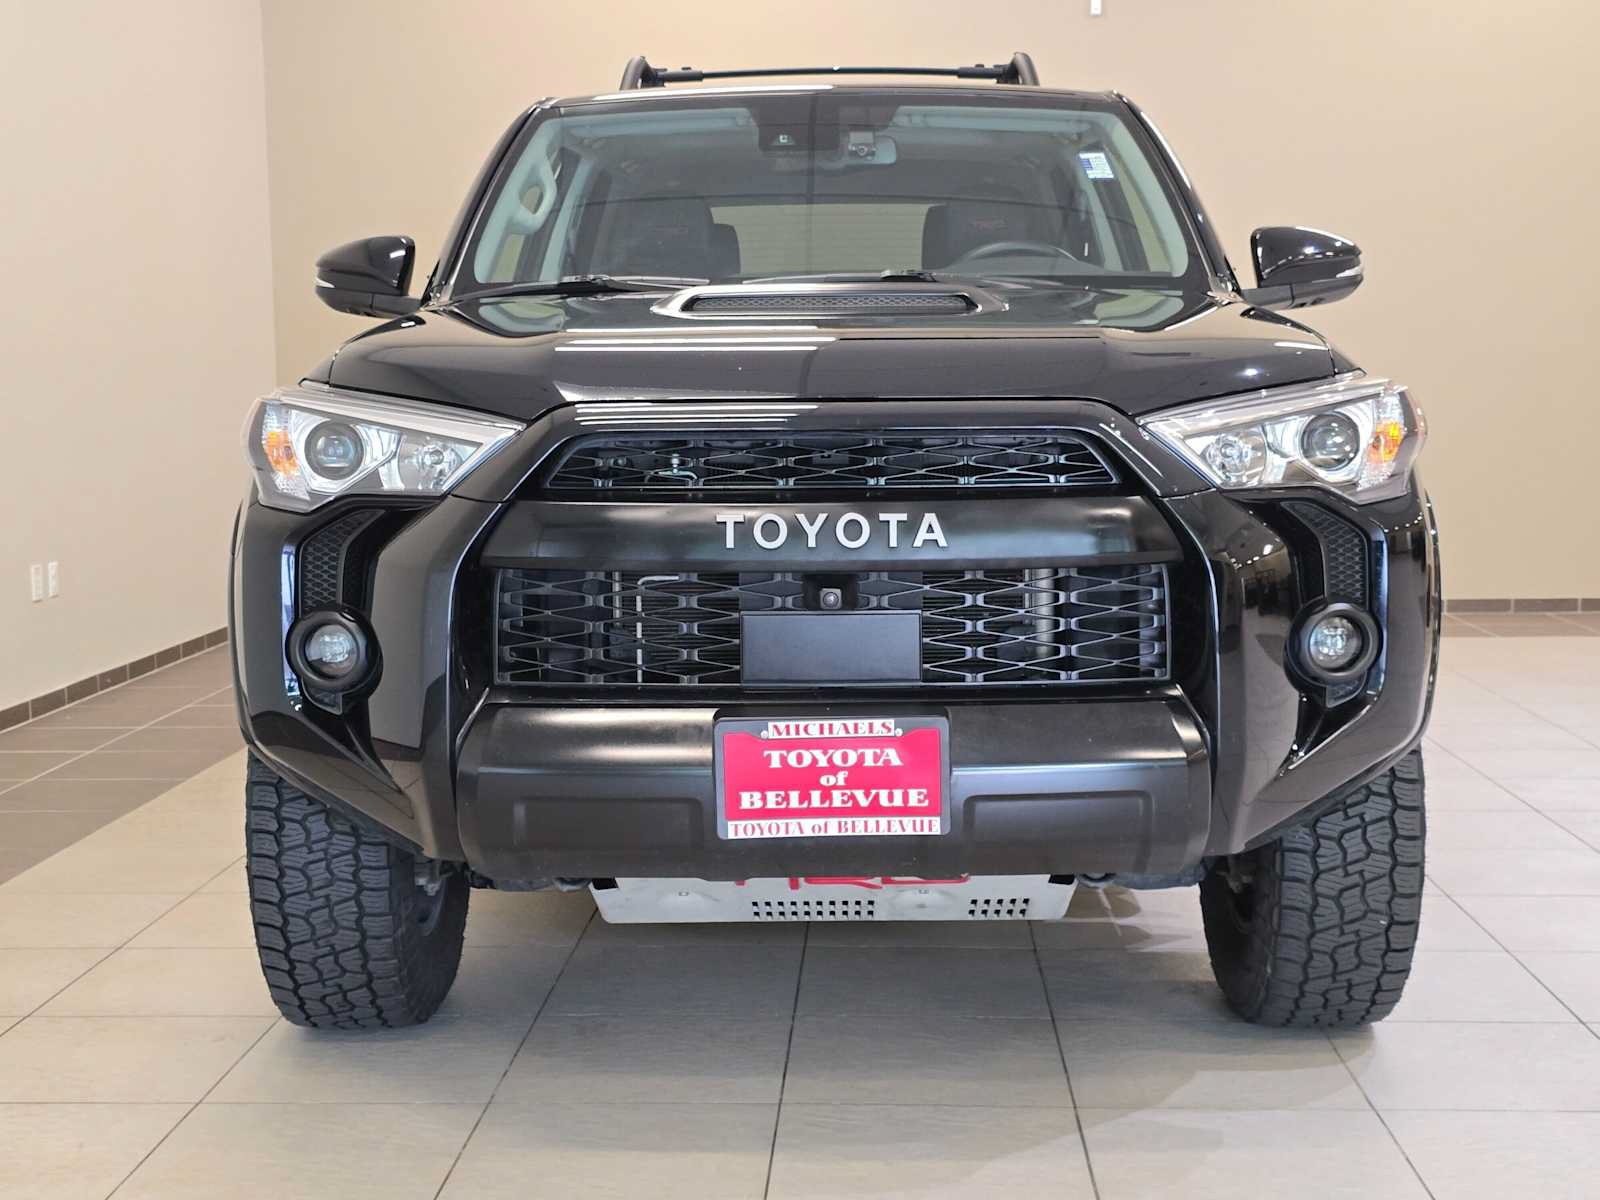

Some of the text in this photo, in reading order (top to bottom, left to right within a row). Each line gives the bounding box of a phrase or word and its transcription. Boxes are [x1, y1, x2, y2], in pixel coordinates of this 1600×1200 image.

[716, 512, 949, 549] TOYOTA
[772, 721, 893, 736] MICHAELS
[764, 748, 903, 768] TOYOTA
[820, 771, 848, 786] of
[738, 788, 929, 810] BELLEVUE
[731, 819, 940, 838] TOYOTA of BELLEVUE
